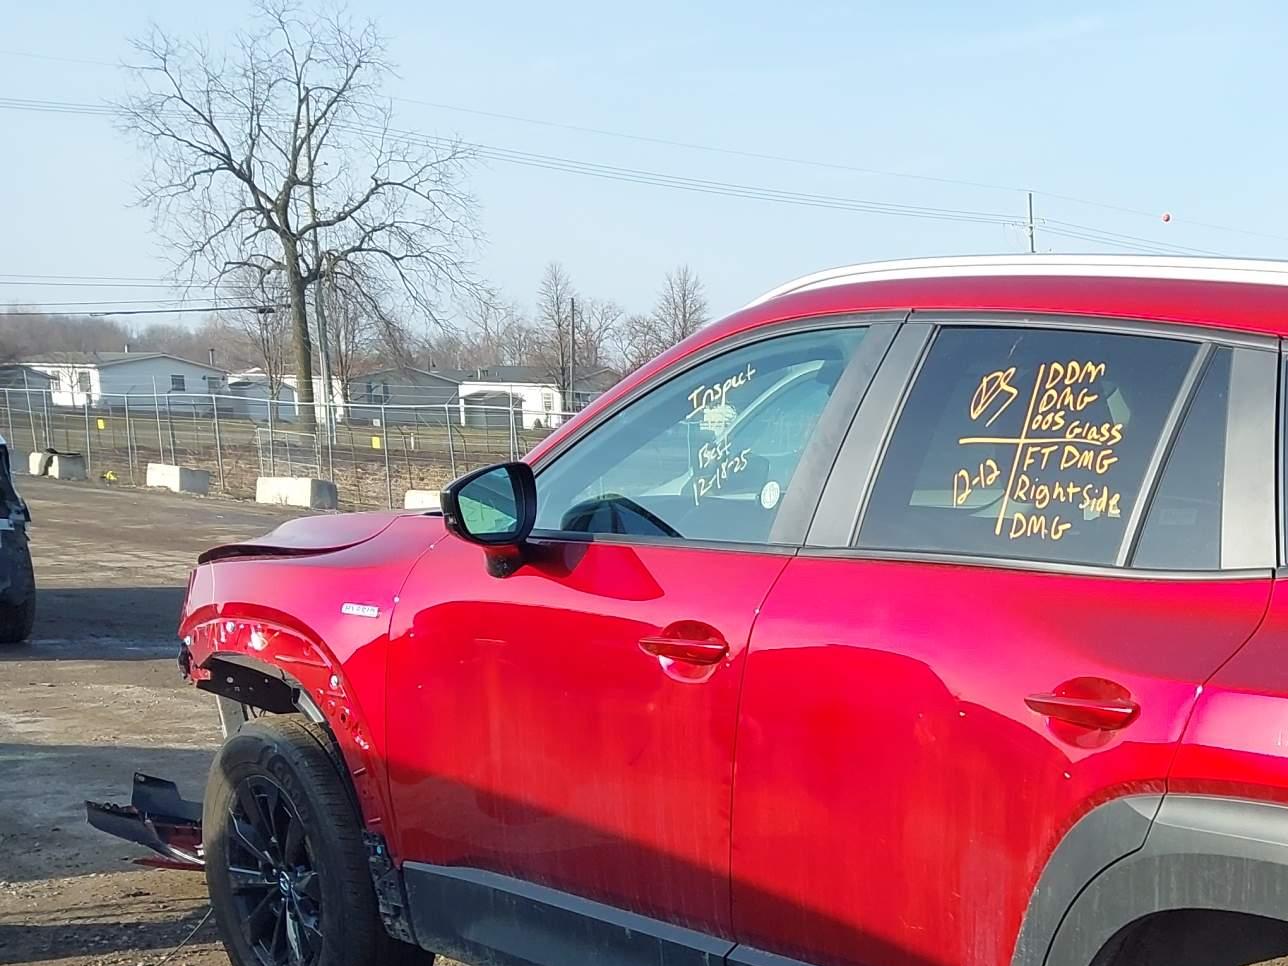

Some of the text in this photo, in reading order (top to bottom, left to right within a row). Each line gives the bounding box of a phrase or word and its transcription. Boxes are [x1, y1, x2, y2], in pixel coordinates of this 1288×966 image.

[1045, 361, 1105, 389] DDM
[686, 363, 756, 419] Inspect
[1038, 386, 1098, 414] DMG
[1065, 420, 1123, 446] Glass
[1023, 445, 1119, 474] FT DMG
[1013, 473, 1081, 509] Right
[1009, 511, 1072, 540] DMG
